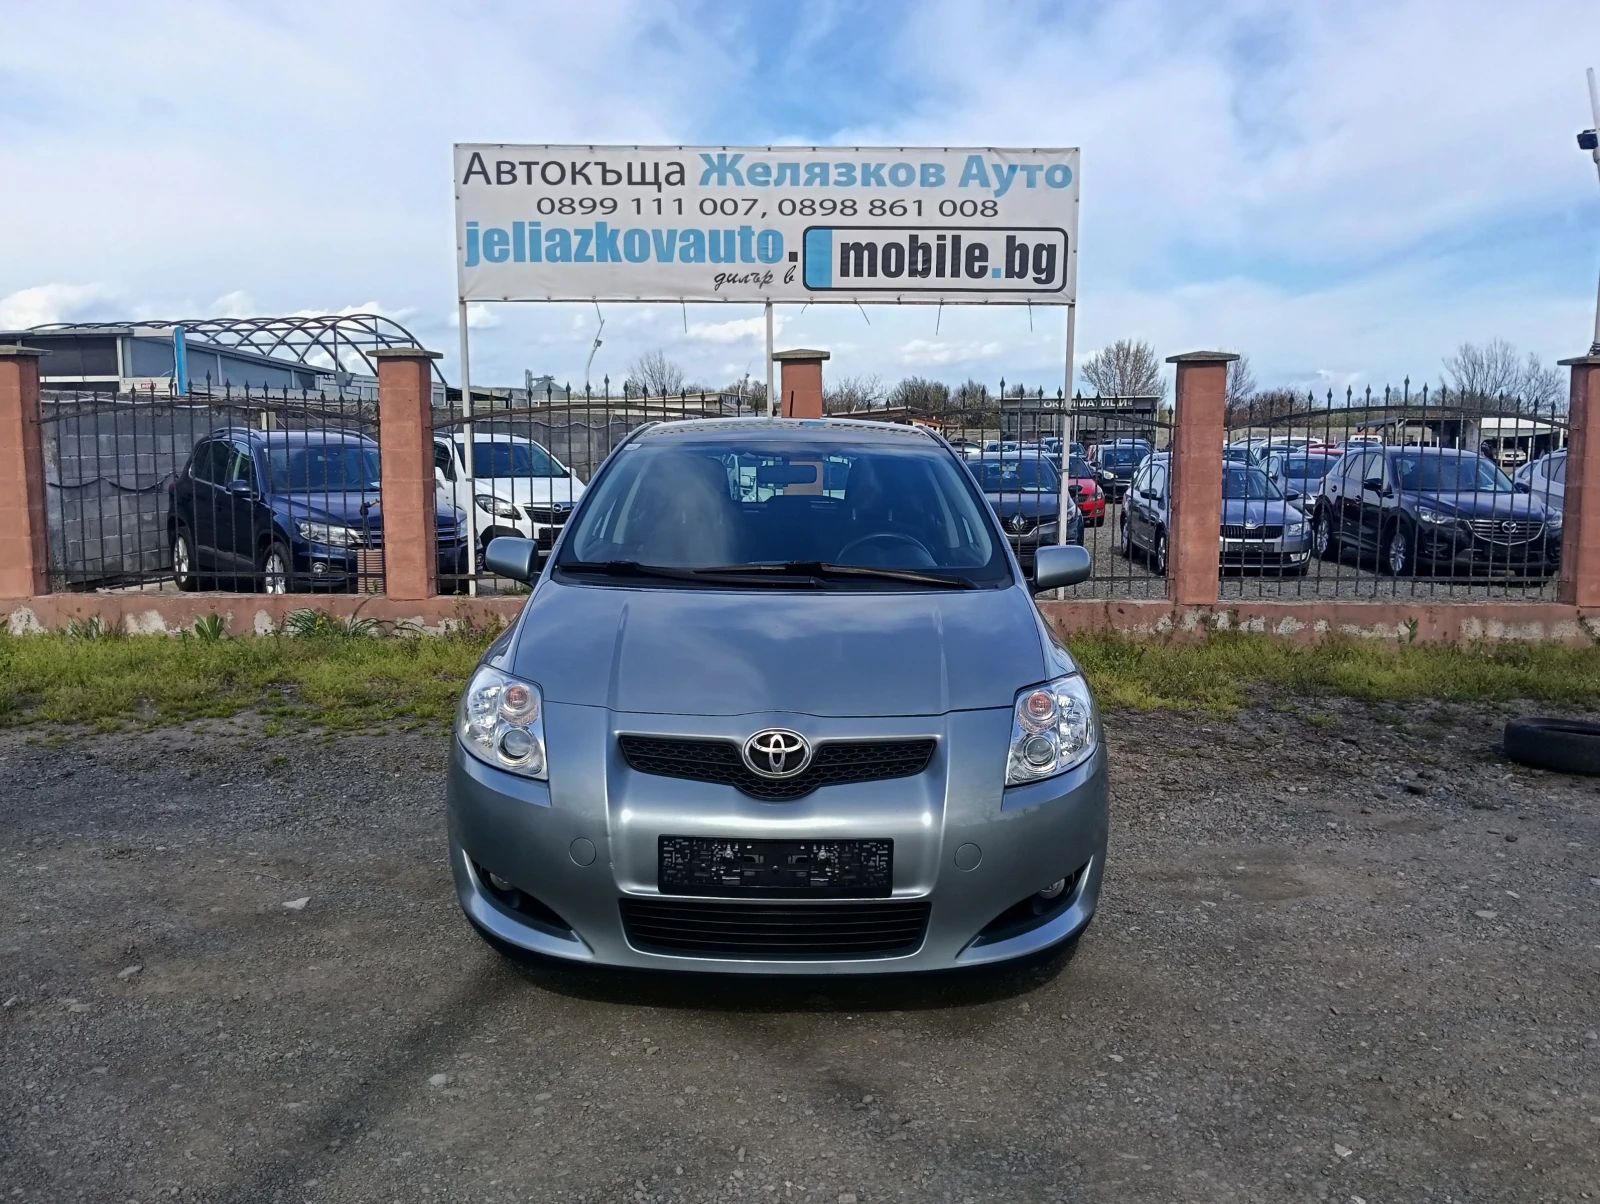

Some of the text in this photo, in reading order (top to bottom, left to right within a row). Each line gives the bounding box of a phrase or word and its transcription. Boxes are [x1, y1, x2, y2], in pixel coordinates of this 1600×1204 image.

[462, 151, 1073, 198] Автокъща Желязков Ауто
[536, 197, 999, 219] 0899 111 007, 0898 861 008
[840, 234, 1057, 285] mobile.bg
[714, 270, 774, 291] дилър
